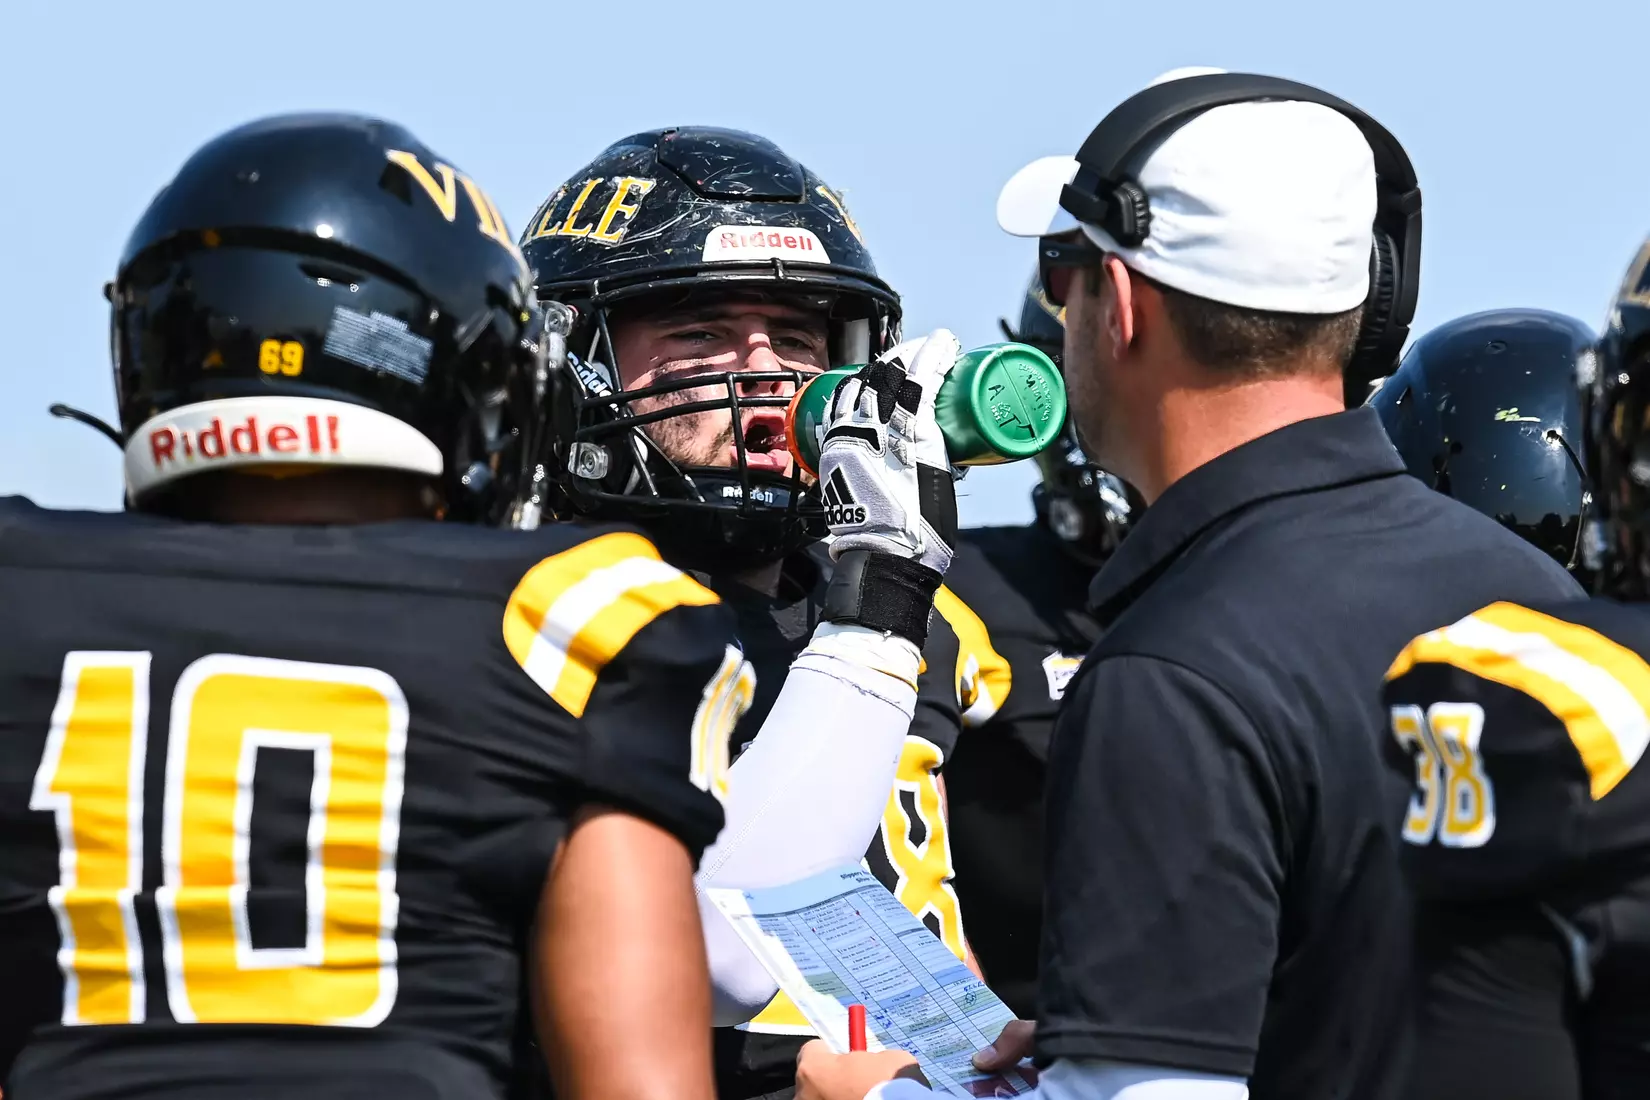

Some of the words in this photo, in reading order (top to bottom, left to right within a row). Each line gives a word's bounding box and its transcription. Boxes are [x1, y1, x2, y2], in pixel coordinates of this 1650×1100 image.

[720, 231, 813, 251] Riddell
[259, 338, 304, 377] 69
[150, 415, 339, 472] Riddell
[1391, 702, 1496, 848] 38
[30, 651, 409, 1028] 10
